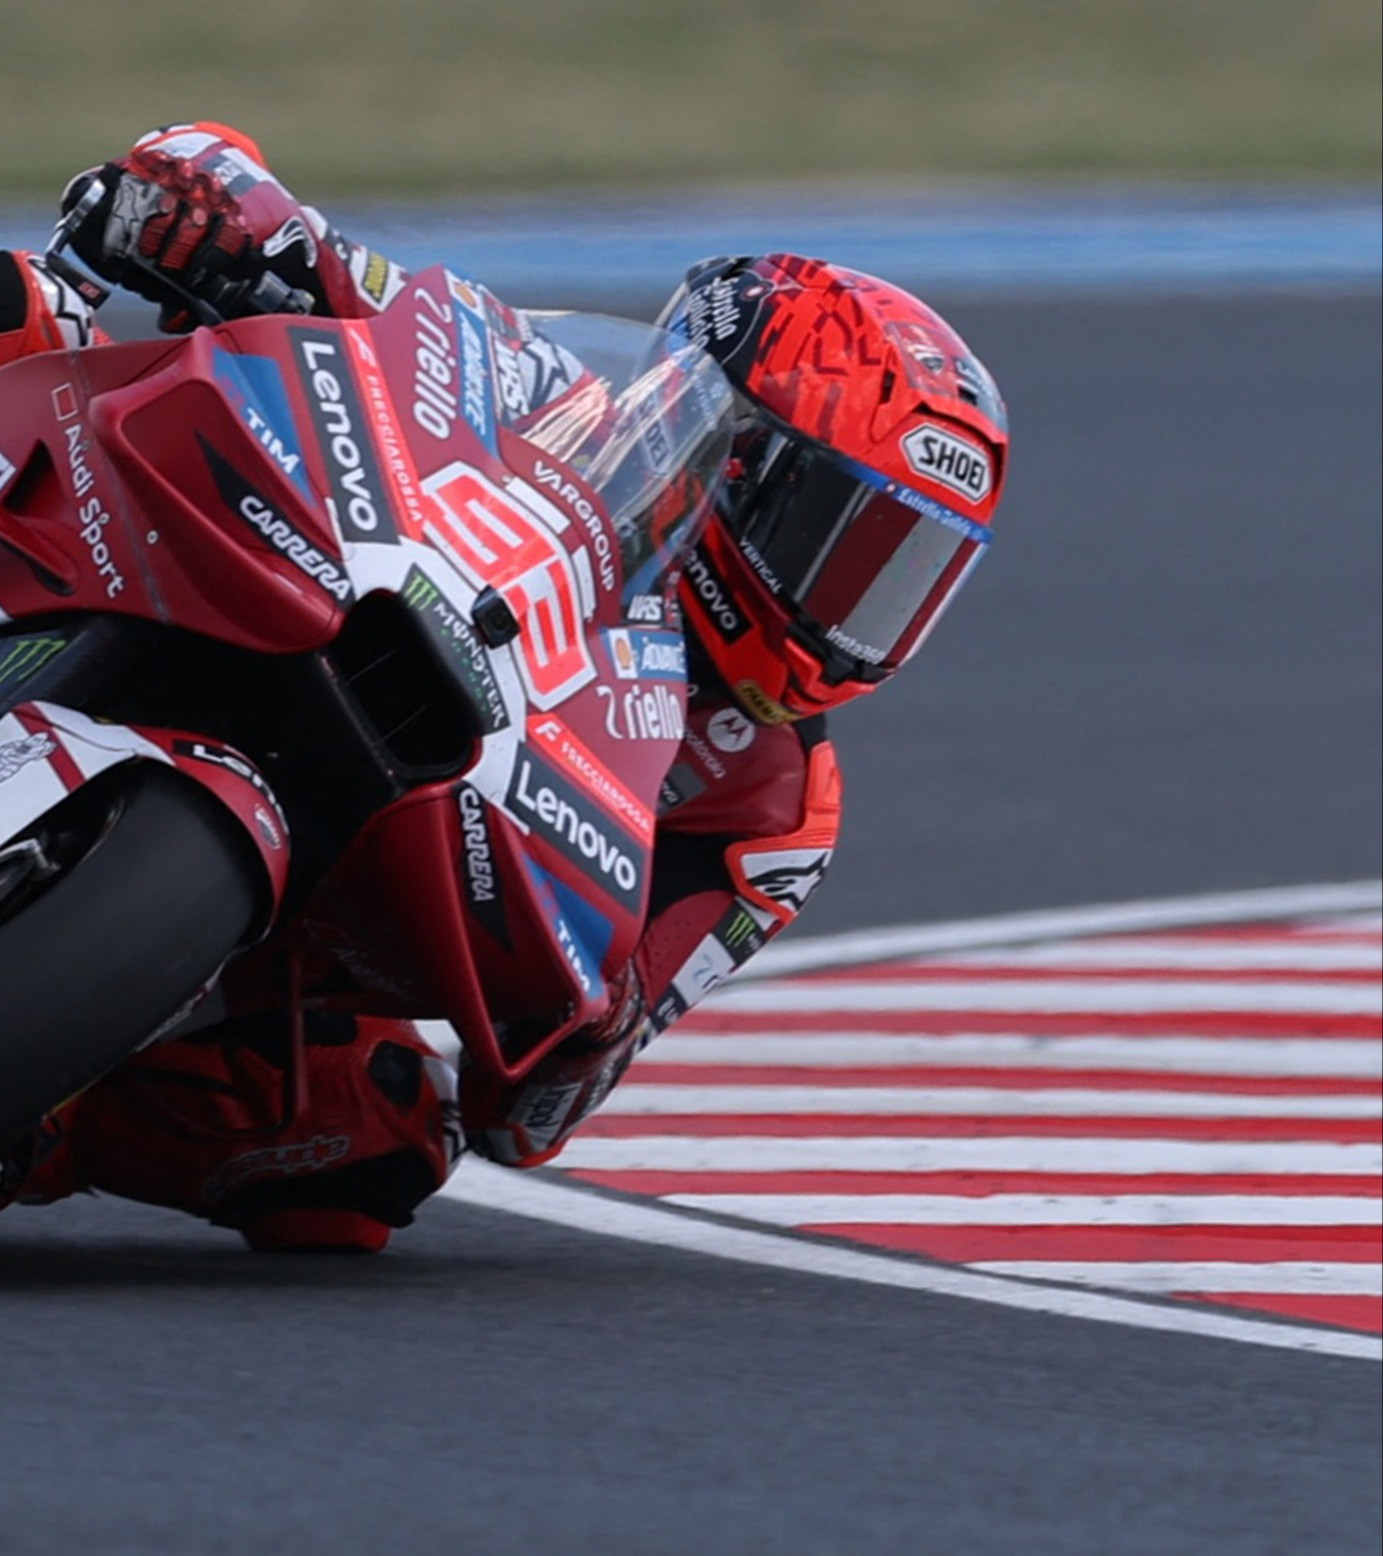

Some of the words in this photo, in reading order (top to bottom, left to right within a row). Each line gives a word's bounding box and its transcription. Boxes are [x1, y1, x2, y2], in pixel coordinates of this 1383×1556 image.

[414, 312, 457, 438] riello
[65, 424, 96, 498] Audi
[245, 407, 300, 475] TIM
[301, 340, 378, 532] Lenovo
[367, 374, 424, 522] FRECCIAROSSA
[919, 436, 985, 489] SHOEI
[79, 497, 125, 599] Sport
[239, 495, 353, 601] CARRERA
[534, 460, 615, 592] VARGROUP
[683, 550, 737, 630] enovo
[433, 602, 505, 728] MONSTER
[623, 684, 684, 740] riello
[457, 787, 495, 903] CARRERA
[516, 760, 636, 891] Lenovo
